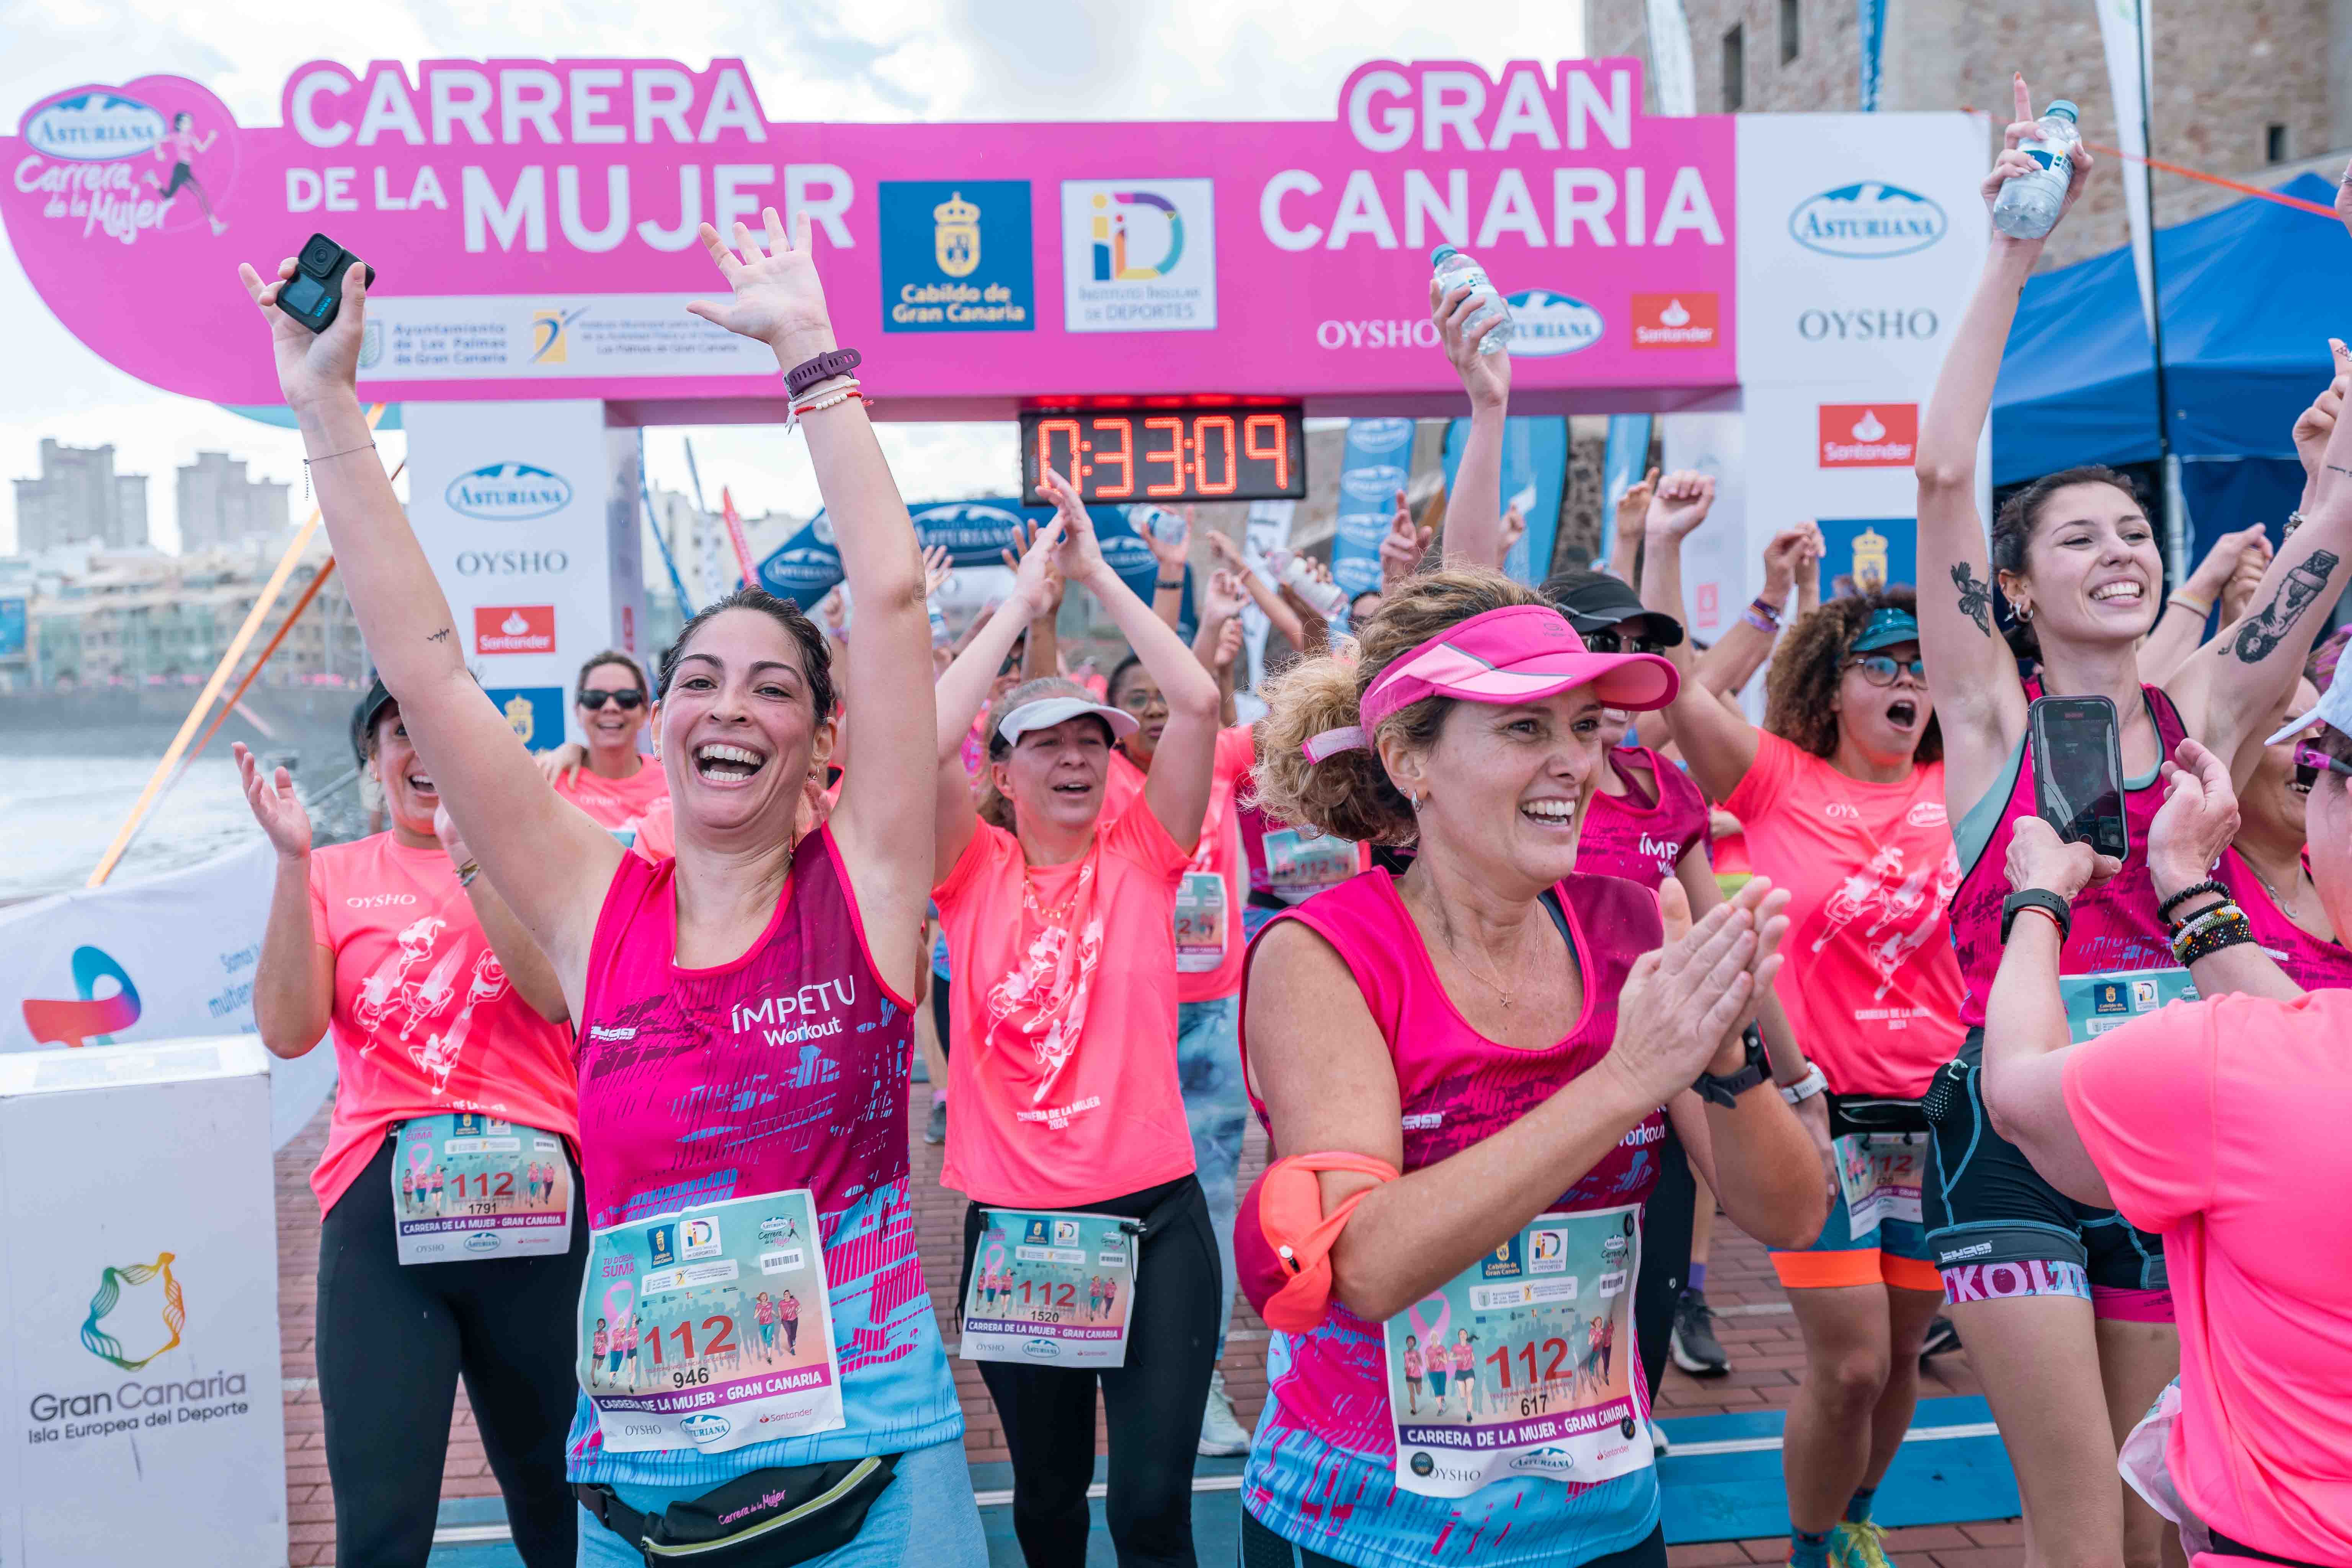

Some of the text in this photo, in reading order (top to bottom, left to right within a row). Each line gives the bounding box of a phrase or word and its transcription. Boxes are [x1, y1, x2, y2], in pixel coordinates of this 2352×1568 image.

[291, 69, 767, 147] CARRERA
[1348, 69, 1631, 153] GRAN
[38, 120, 155, 145] ASTURIANA
[14, 155, 135, 192] Carrera
[44, 191, 67, 218] de
[83, 186, 176, 244] Mujer
[286, 163, 856, 253] DE LA MUJER
[1259, 167, 1725, 251] CANARIA
[1802, 212, 1934, 239] ASTURIANA
[902, 283, 1009, 303] Cabildo de
[892, 303, 1025, 323] Gran Canaria
[1106, 304, 1194, 319] DEPORTES
[394, 322, 506, 338] Ayuntamiento
[1317, 318, 1441, 349] OYSHO
[1512, 322, 1592, 338] TURIANA
[1636, 325, 1713, 343] Santander
[1798, 309, 1938, 340] OYSHO
[394, 336, 507, 350] de Las Palmas
[395, 352, 507, 364] de Gran Canaria
[1824, 442, 1913, 461] Santander
[459, 487, 562, 506] ASTURIANA
[457, 549, 568, 575] OYSHO
[480, 634, 551, 650] Santander
[346, 894, 416, 908] OYSHO
[732, 975, 855, 1034] ÍMPETU
[764, 1017, 842, 1047] Workout
[467, 1101, 478, 1110] LA
[1049, 1109, 1060, 1119] DE
[1061, 1106, 1072, 1116] LA
[1072, 1096, 1101, 1112] MUJER
[1049, 1117, 1069, 1130] 2024
[450, 1173, 514, 1198] 112
[469, 1203, 497, 1215] 1791
[403, 1215, 561, 1234] CARRERA DE LA MUJER GRAN CANARIA
[758, 1231, 782, 1240] Carrera
[416, 1244, 444, 1253] OYSHO
[601, 1262, 634, 1278] SUMA
[1018, 1280, 1076, 1308] 112
[1031, 1311, 1060, 1323] 1520
[644, 1315, 736, 1364] 112
[968, 1321, 1118, 1339] CARRERA DE LA MUJER GRAN CANARIA
[976, 1343, 1005, 1352] OYSHO
[1025, 1345, 1057, 1355] ASTURIANA
[1486, 1337, 1572, 1388] 112
[673, 1367, 709, 1389] 946
[30, 1370, 247, 1422] Gran Canaria
[600, 1370, 822, 1411] CARRERA DE LA MUJER GRAN CANARIA
[1521, 1394, 1548, 1416] 617
[28, 1401, 248, 1444] Isla Europea del Deporte
[625, 1408, 813, 1437] OYSHO URIANA Santander
[1407, 1404, 1630, 1446] CARRERA DE LA MUJER GRAN CANARIA
[1429, 1445, 1630, 1481] OYSHO ASTURIANA Santander
[718, 1506, 750, 1525] Carrera
[751, 1504, 756, 1512] de
[762, 1489, 786, 1509] Mujer
